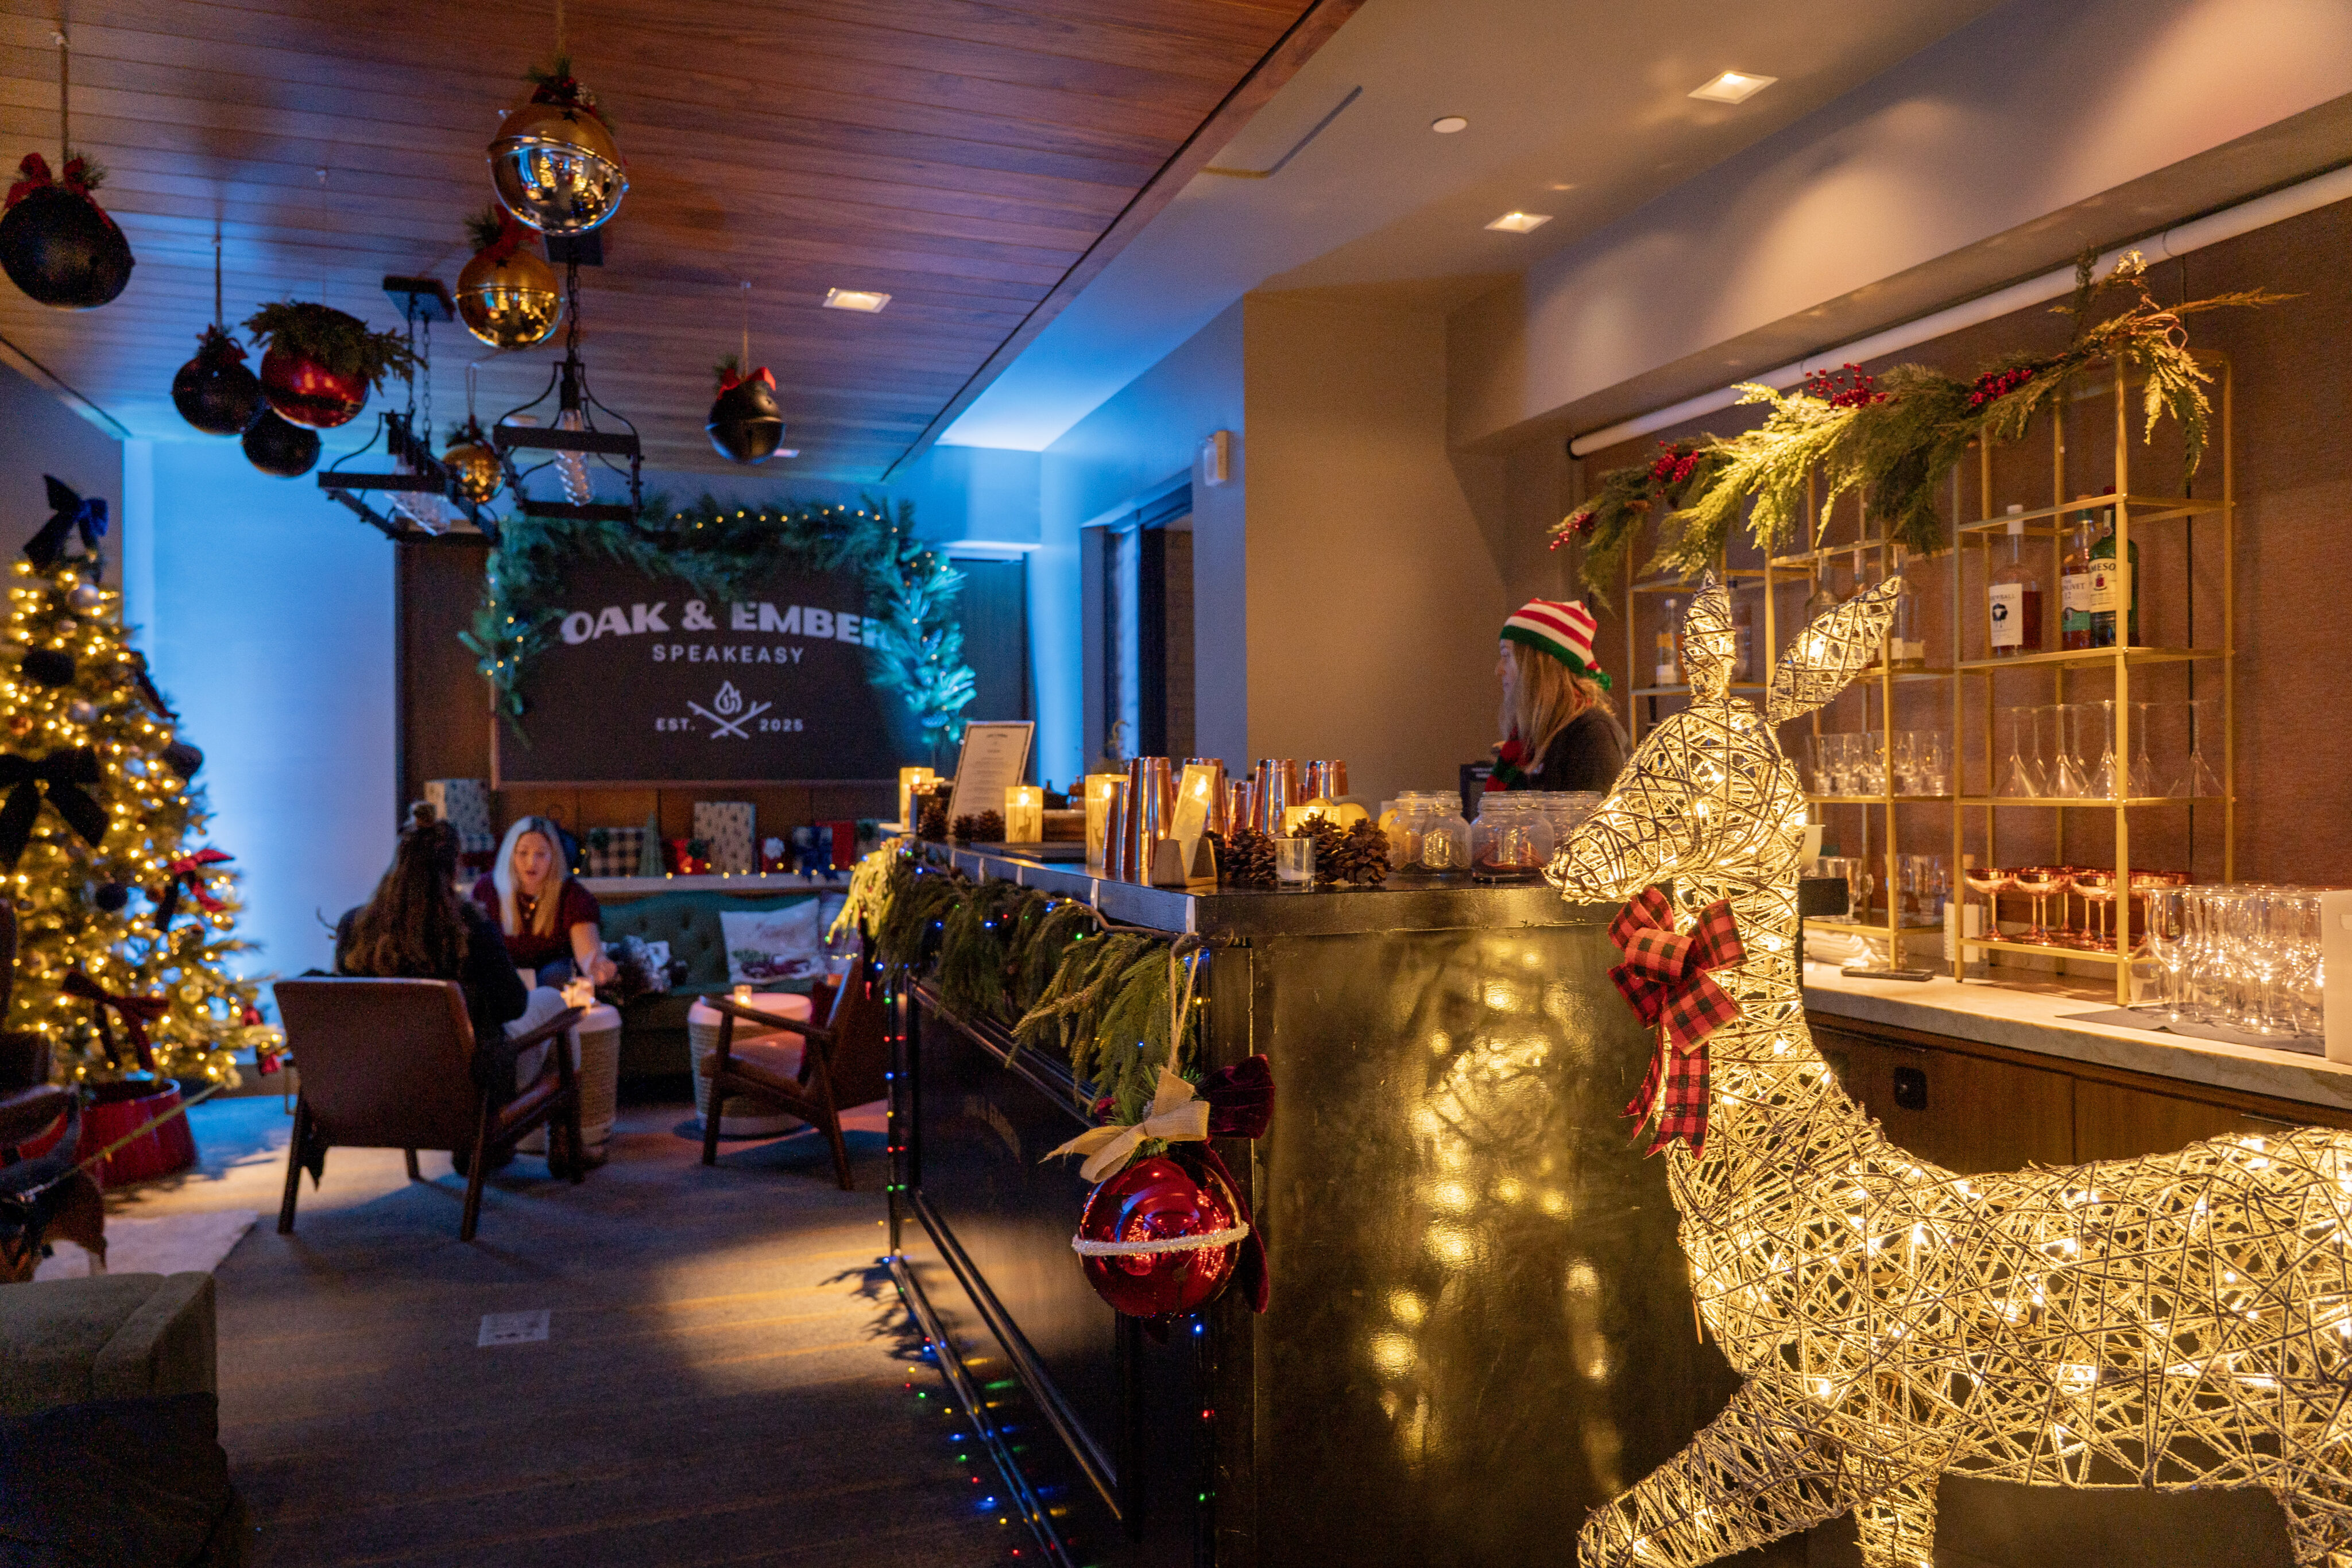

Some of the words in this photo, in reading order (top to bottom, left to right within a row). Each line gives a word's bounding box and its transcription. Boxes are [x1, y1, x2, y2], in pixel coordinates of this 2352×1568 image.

[560, 601, 670, 645] OAK
[681, 599, 717, 631] &
[652, 644, 803, 664] SPEAKEASY
[655, 718, 696, 731] EST.
[759, 718, 803, 732] 2025
